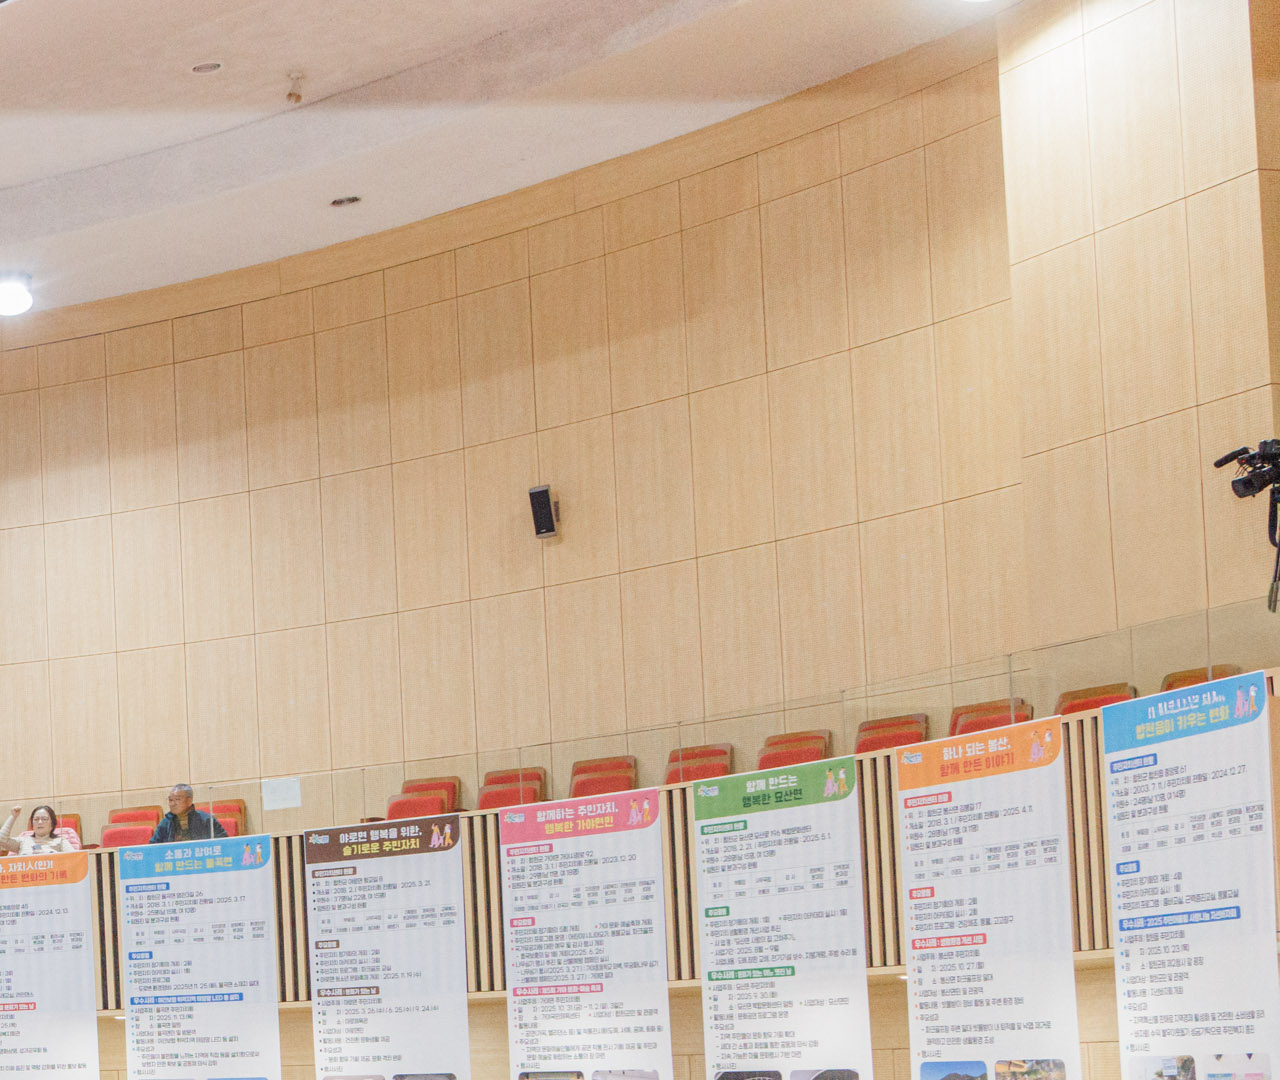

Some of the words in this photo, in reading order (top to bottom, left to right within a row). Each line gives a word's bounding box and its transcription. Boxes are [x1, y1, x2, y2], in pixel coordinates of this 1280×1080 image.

[943, 746, 962, 760] 하나
[966, 742, 985, 756] 되는
[941, 763, 959, 776] 함께
[964, 759, 982, 773] 만든
[986, 752, 1014, 768] 이야기
[746, 779, 766, 792] 함께
[769, 775, 798, 788] 만드는
[743, 795, 771, 808] 행복한
[775, 789, 802, 802] 묘산면
[536, 808, 575, 822] 함께하는
[370, 828, 397, 840] 행복을
[545, 823, 573, 834] 행복한
[343, 842, 379, 856] 슬기로운
[383, 839, 419, 850] 주민자치
